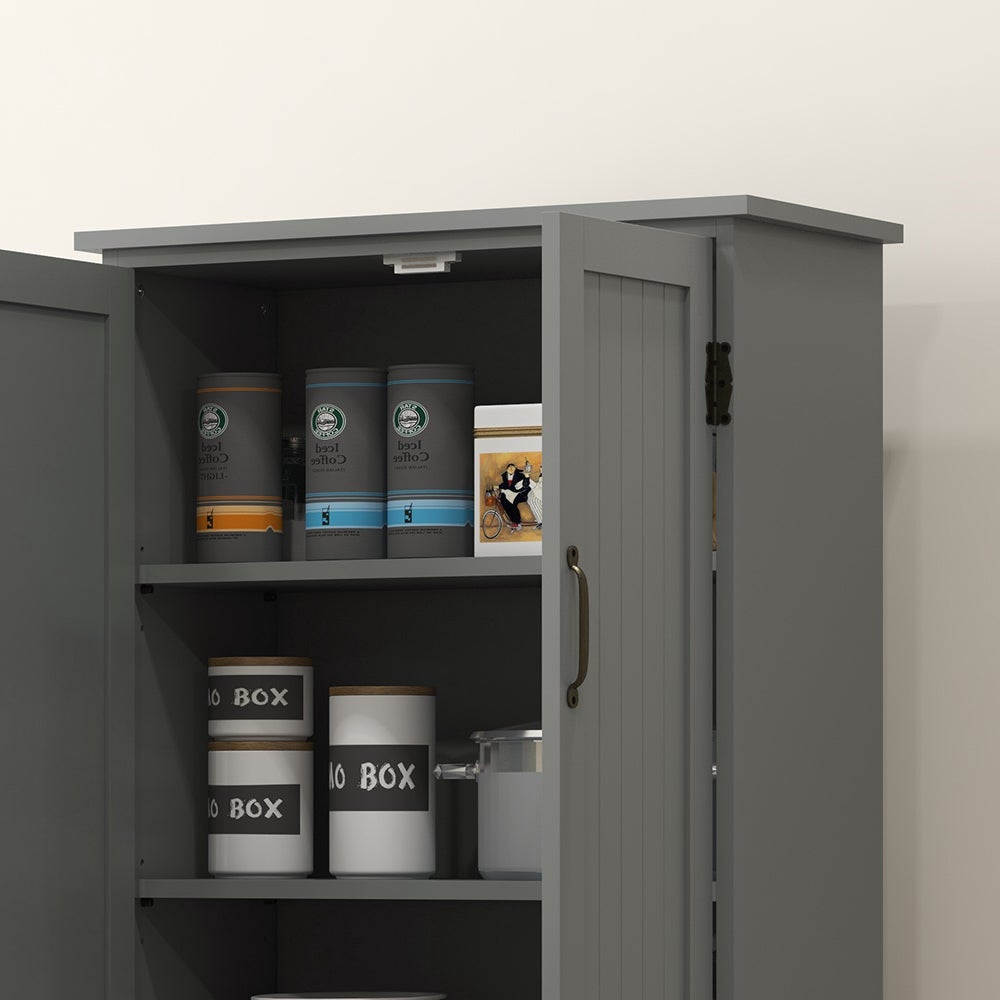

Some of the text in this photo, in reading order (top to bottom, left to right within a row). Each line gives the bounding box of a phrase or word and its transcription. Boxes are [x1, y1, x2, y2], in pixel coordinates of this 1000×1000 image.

[234, 687, 289, 707] BOX
[359, 761, 416, 791] BOX
[229, 797, 283, 820] BOX
